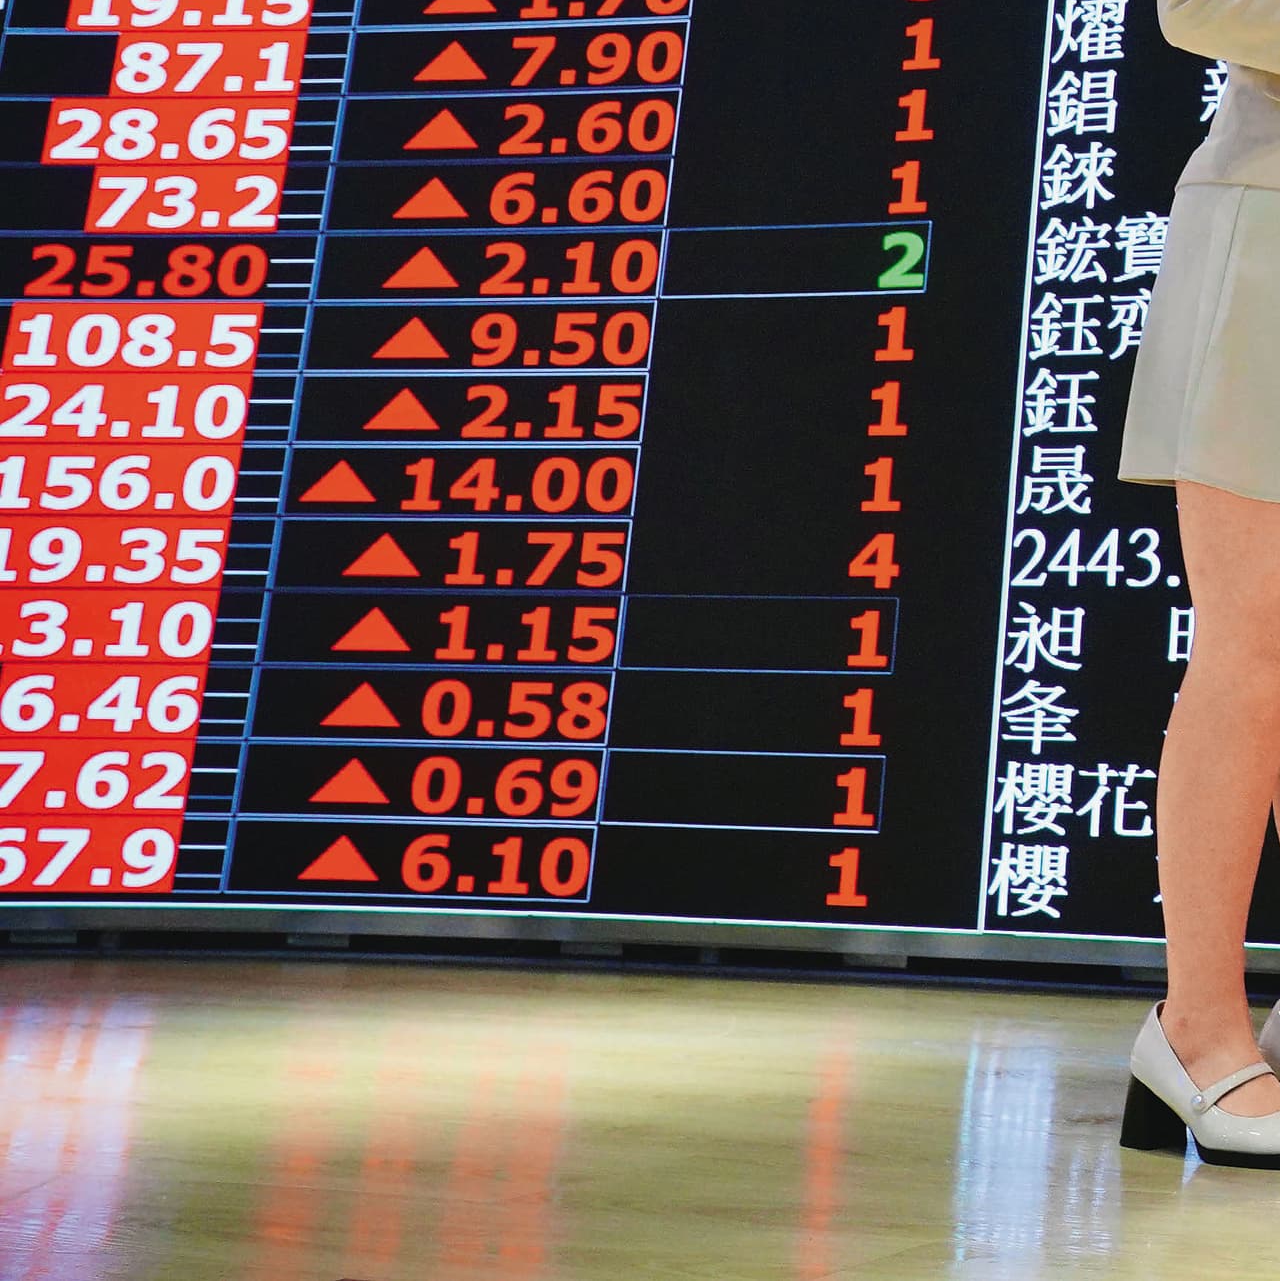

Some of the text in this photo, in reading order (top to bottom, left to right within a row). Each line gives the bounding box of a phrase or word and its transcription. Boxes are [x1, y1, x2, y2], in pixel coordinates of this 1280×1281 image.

[116, 42, 294, 93] 87.1
[511, 31, 682, 86] 7.90
[903, 19, 940, 70] 1
[499, 100, 674, 154] 2.60
[1047, 70, 1118, 136] 錩
[51, 108, 290, 160] 28.65
[96, 176, 277, 228] 73.2
[490, 169, 666, 224] 6.60
[1040, 142, 1117, 210] 錸
[24, 244, 267, 297] 25.80
[480, 240, 658, 294] 2.10
[878, 232, 924, 288] 2
[13, 314, 257, 367] 108.5
[471, 311, 649, 366] 9.50
[0, 384, 245, 438] 24.10
[461, 384, 642, 438] 2.15
[401, 457, 633, 512] 14.00
[1016, 445, 1093, 514] 晟
[445, 532, 625, 587] 1.75
[849, 534, 899, 588] 4
[435, 606, 616, 662] 1.15
[1005, 602, 1085, 673] 昶
[1, 675, 198, 732] 6.46
[422, 680, 608, 739] 0.58
[1001, 680, 1079, 754] 夆
[0, 752, 186, 808] 7.62
[412, 757, 598, 817] 0.69
[994, 761, 1156, 837] 櫻花
[402, 834, 589, 896] 6.10
